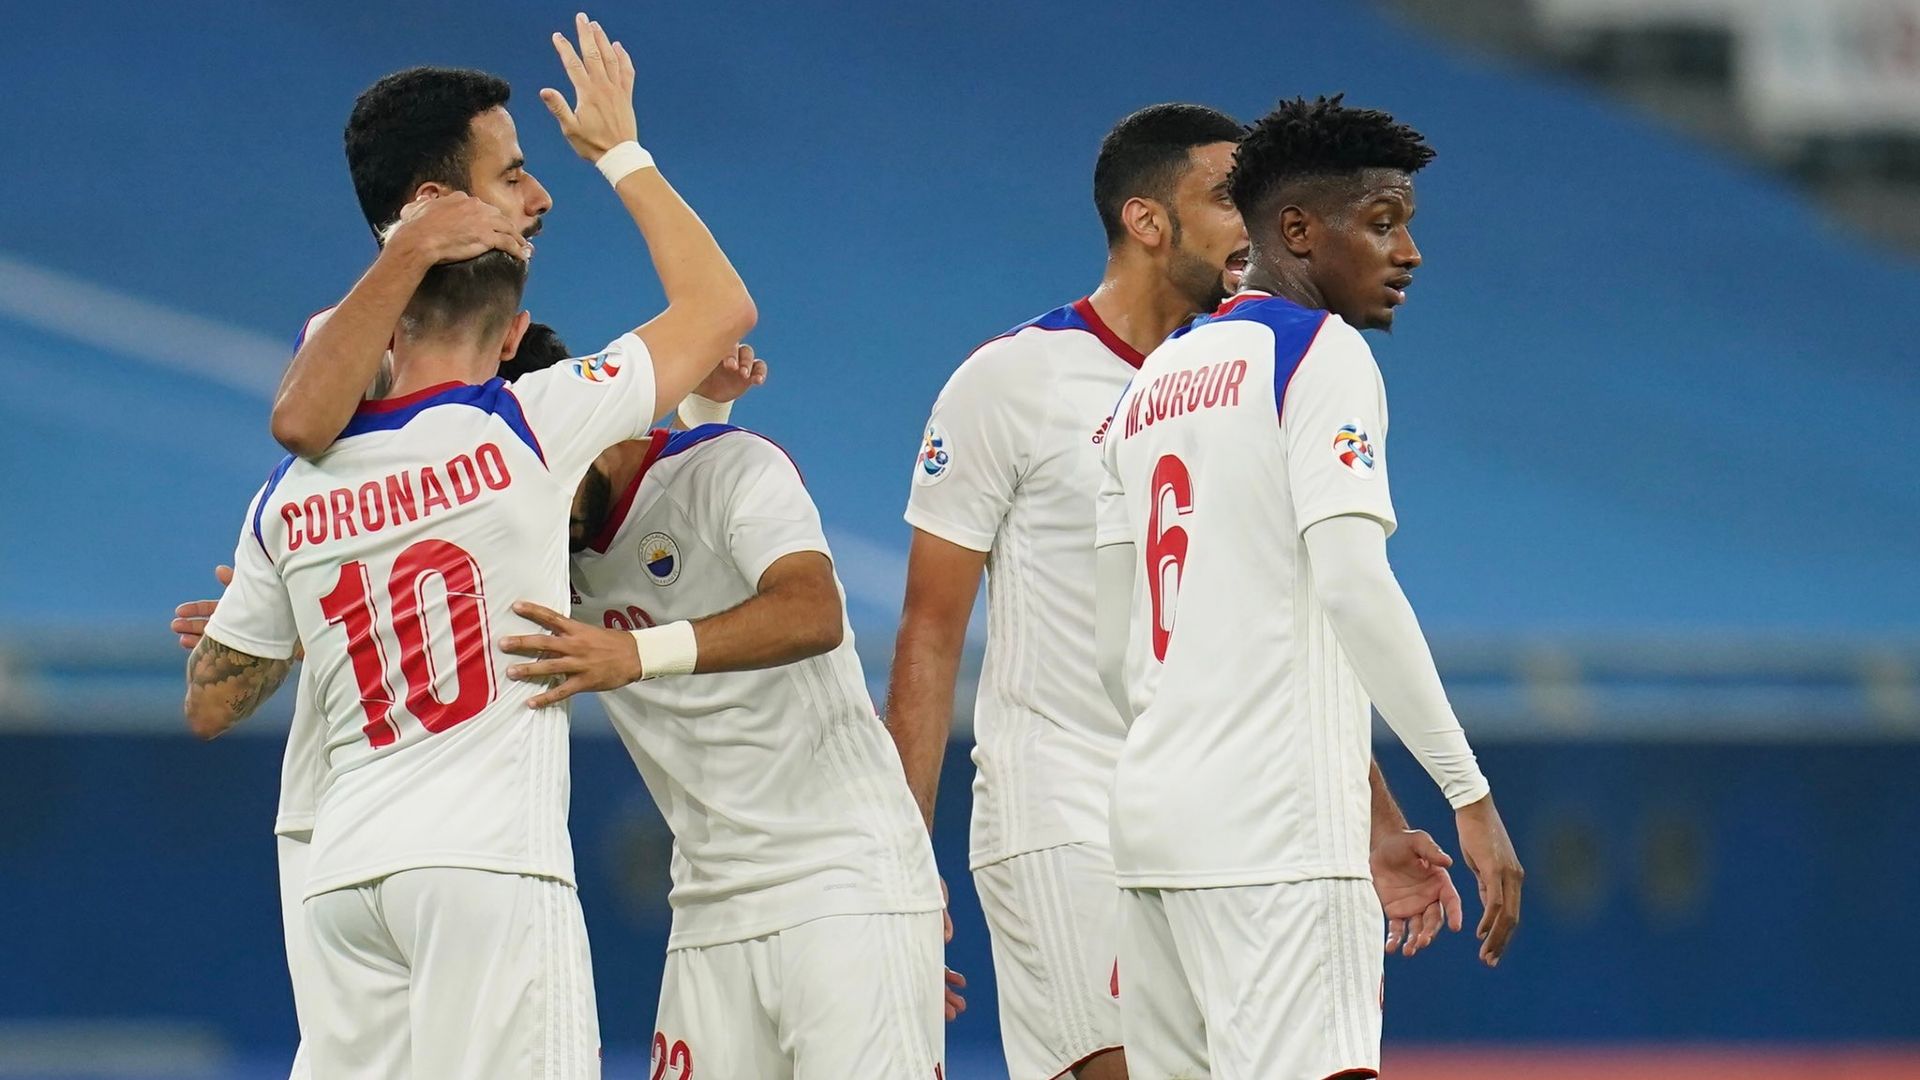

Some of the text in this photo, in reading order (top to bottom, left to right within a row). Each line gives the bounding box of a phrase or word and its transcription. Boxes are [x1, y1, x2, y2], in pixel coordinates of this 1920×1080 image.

[1125, 360, 1247, 439] M.SUROUR
[281, 443, 511, 551] CORONADO
[1146, 454, 1194, 664] 6
[320, 539, 497, 750] 10
